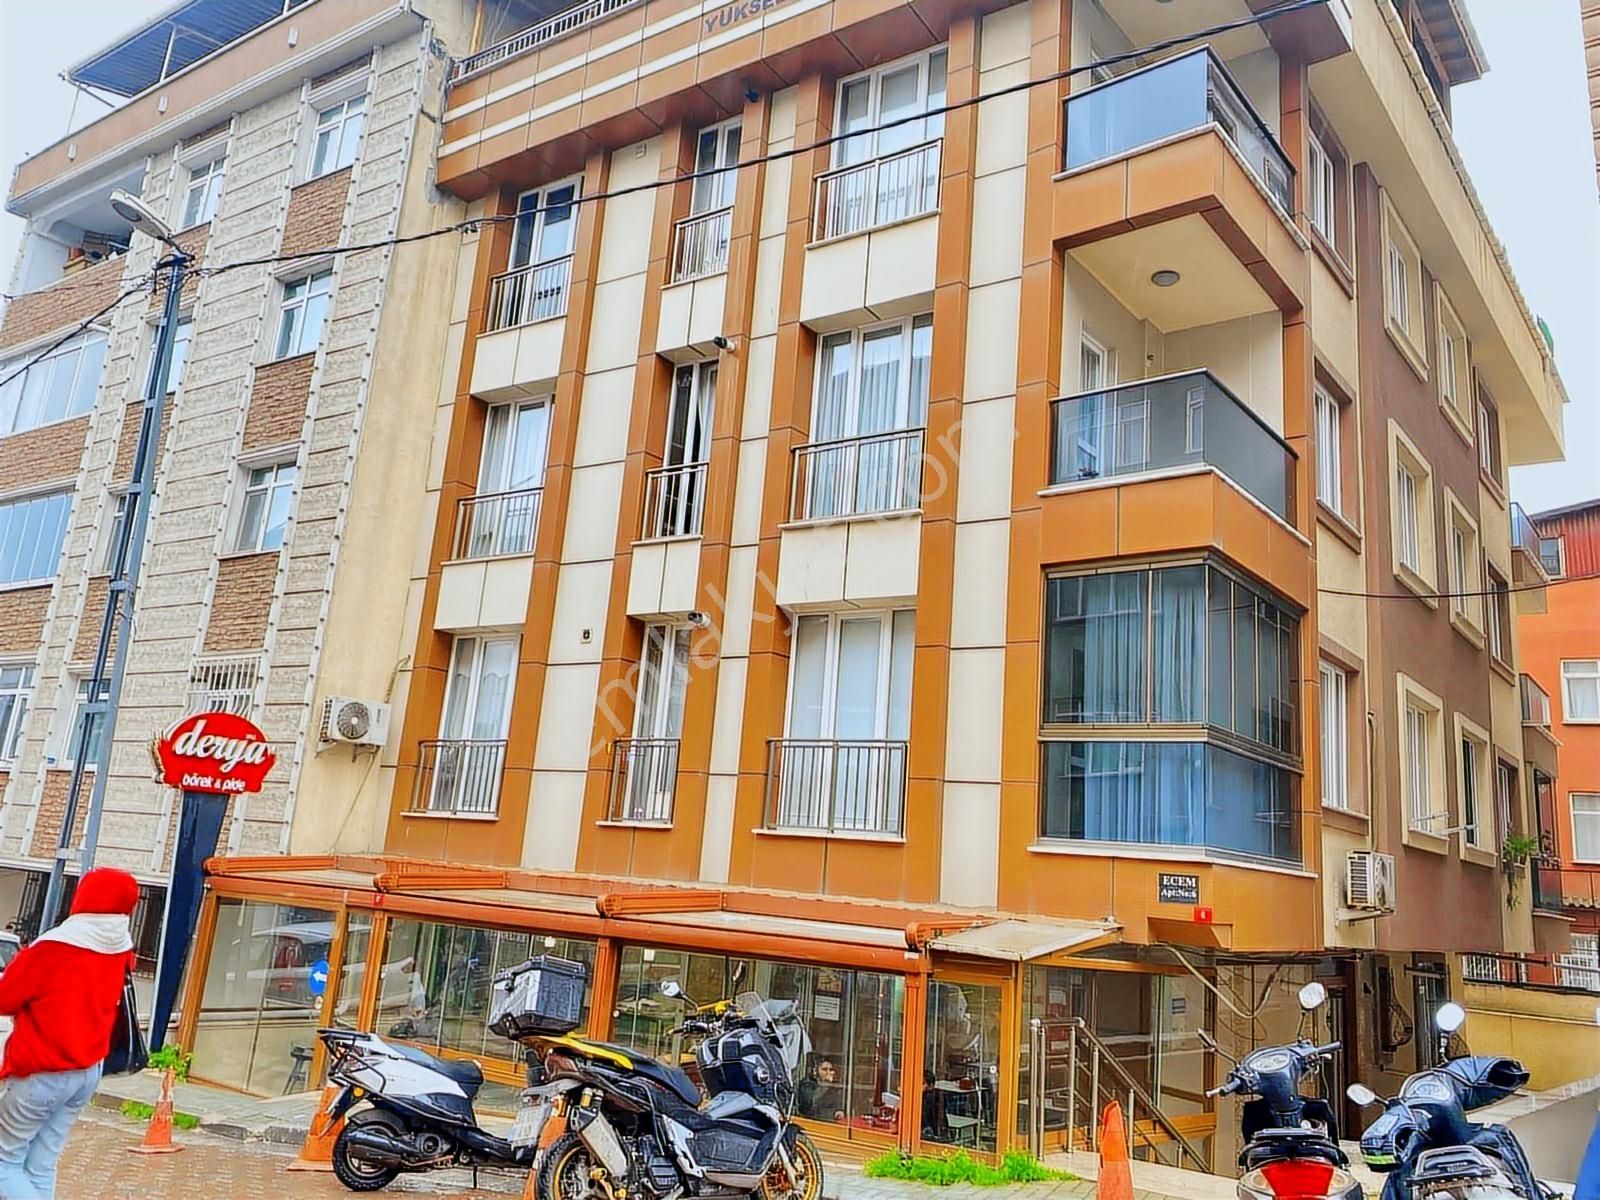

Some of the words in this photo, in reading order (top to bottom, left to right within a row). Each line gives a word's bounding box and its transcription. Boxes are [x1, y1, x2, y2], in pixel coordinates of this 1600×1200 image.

[173, 719, 267, 773] derya
[223, 778, 246, 791] pide
[1163, 875, 1196, 887] ECEM
